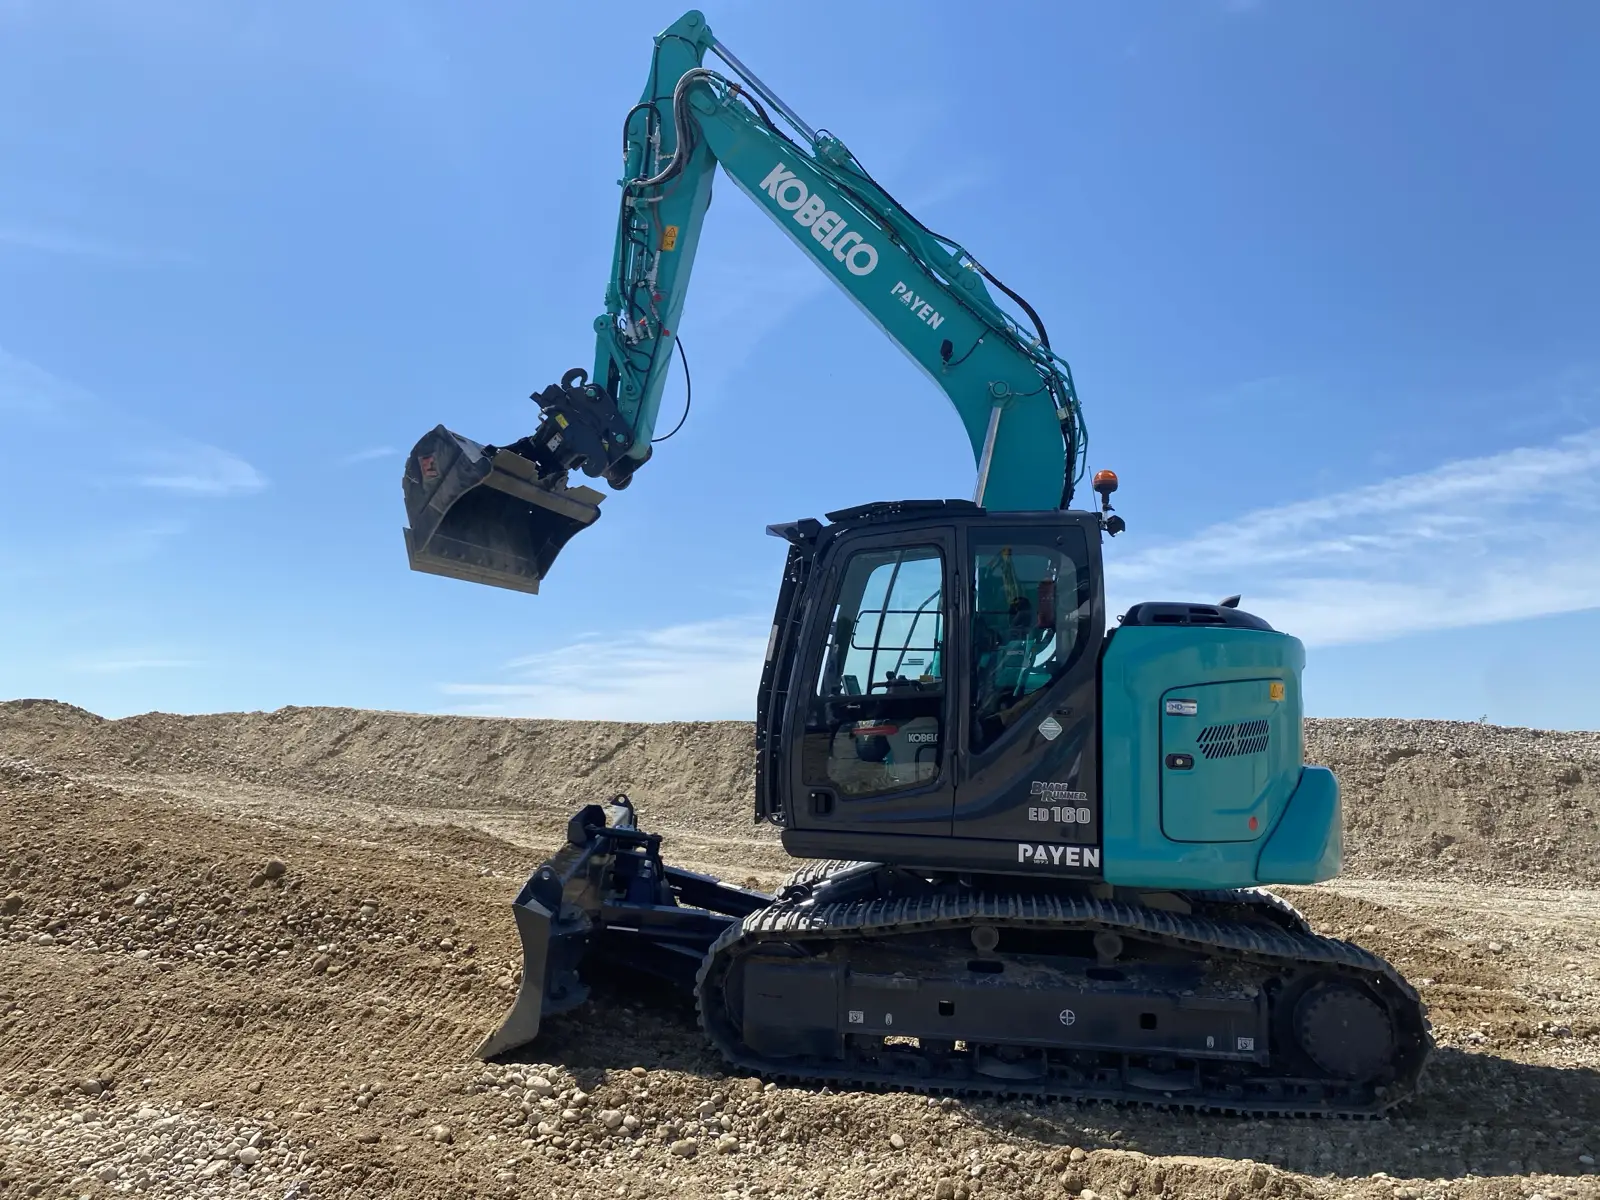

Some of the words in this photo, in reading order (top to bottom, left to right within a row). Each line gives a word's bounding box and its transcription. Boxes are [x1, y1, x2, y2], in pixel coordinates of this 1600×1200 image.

[759, 162, 879, 276] KOBELCO
[890, 281, 945, 330] PAYEN
[1030, 781, 1068, 795] BLADE
[1040, 790, 1088, 802] RUNNER
[1018, 843, 1100, 868] PAYEN
